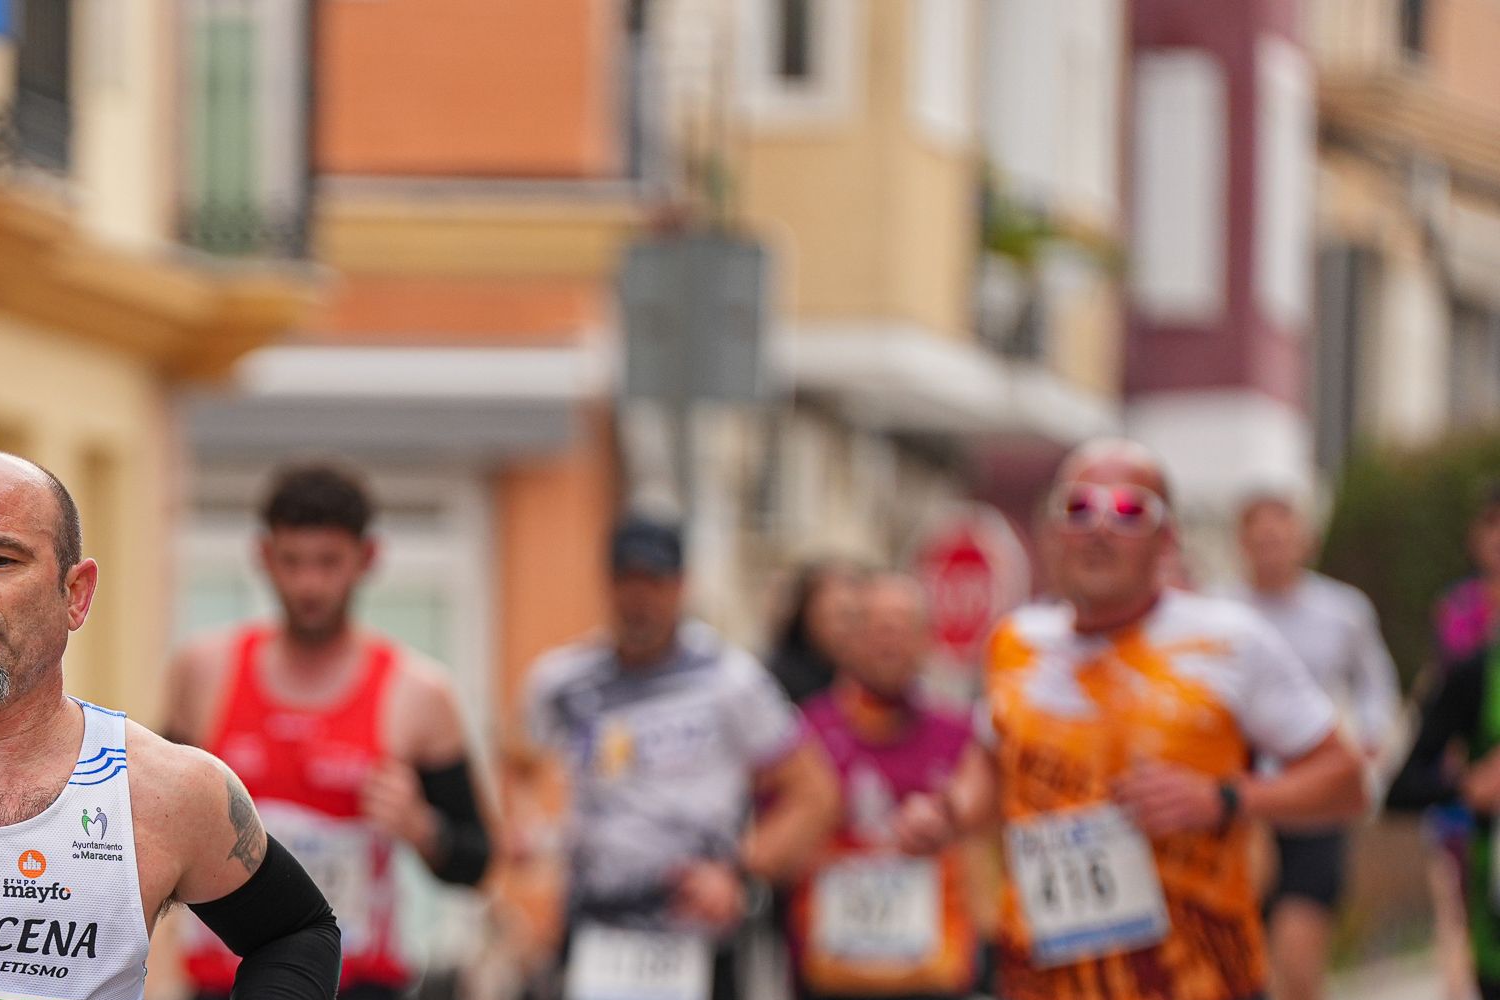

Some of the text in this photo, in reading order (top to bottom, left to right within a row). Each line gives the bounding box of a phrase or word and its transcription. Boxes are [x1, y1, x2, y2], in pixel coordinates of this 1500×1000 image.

[72, 841, 123, 850] Ayuntamiento
[81, 851, 123, 861] Maracena
[3, 878, 36, 887] grupo
[3, 882, 72, 904] mayfo
